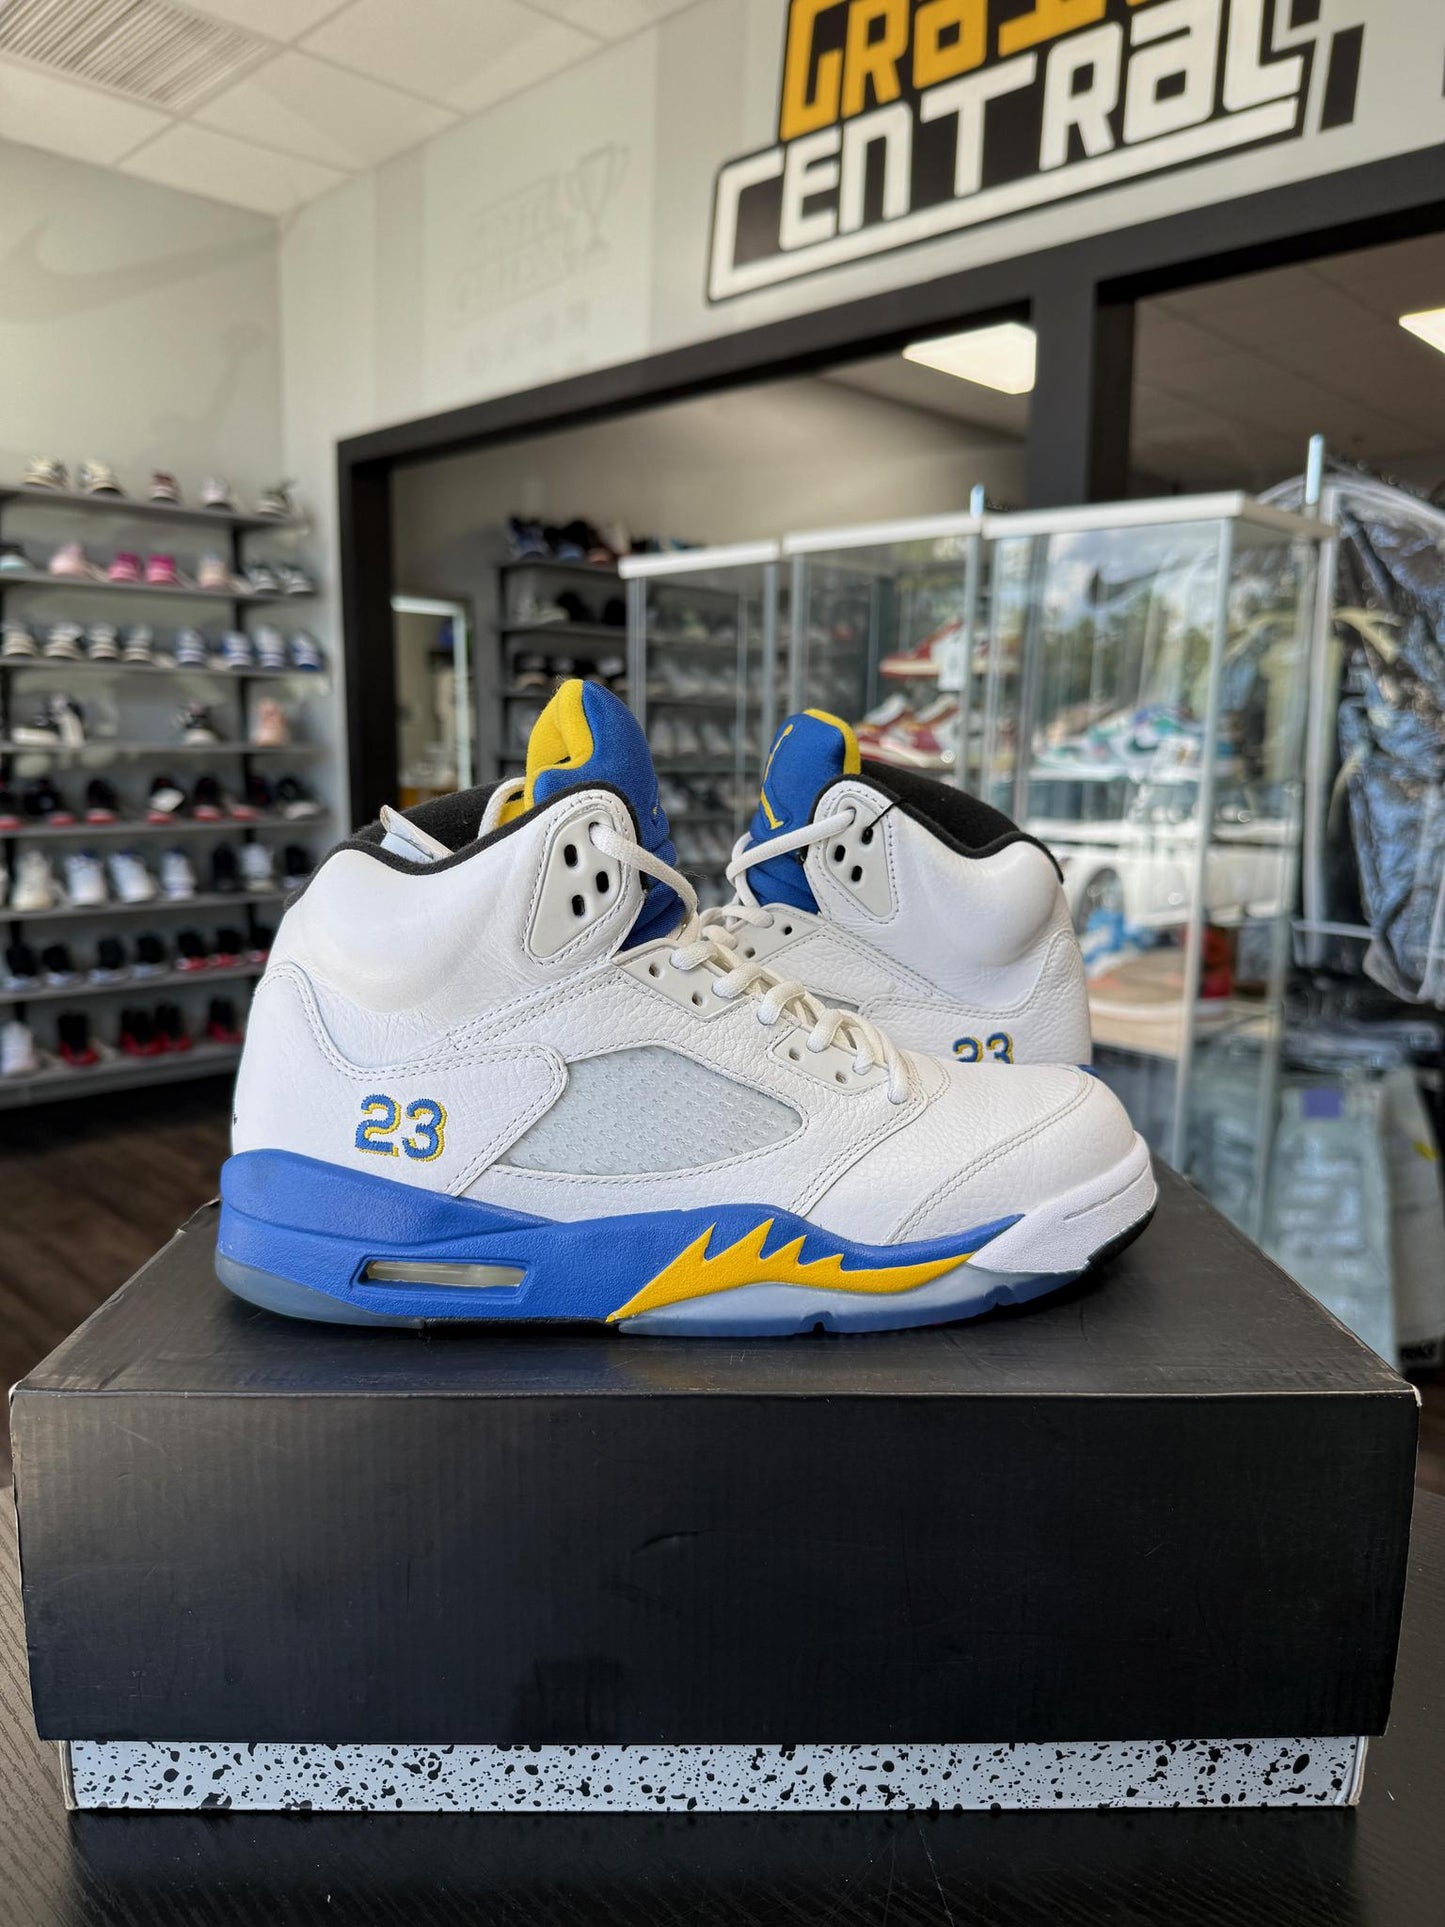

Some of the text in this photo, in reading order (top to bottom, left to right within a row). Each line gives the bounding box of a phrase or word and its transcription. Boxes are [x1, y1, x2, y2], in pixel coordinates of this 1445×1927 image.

[708, 0, 1304, 301] CENTRAL
[952, 1031, 1015, 1064] 23
[355, 1093, 448, 1162] 23
